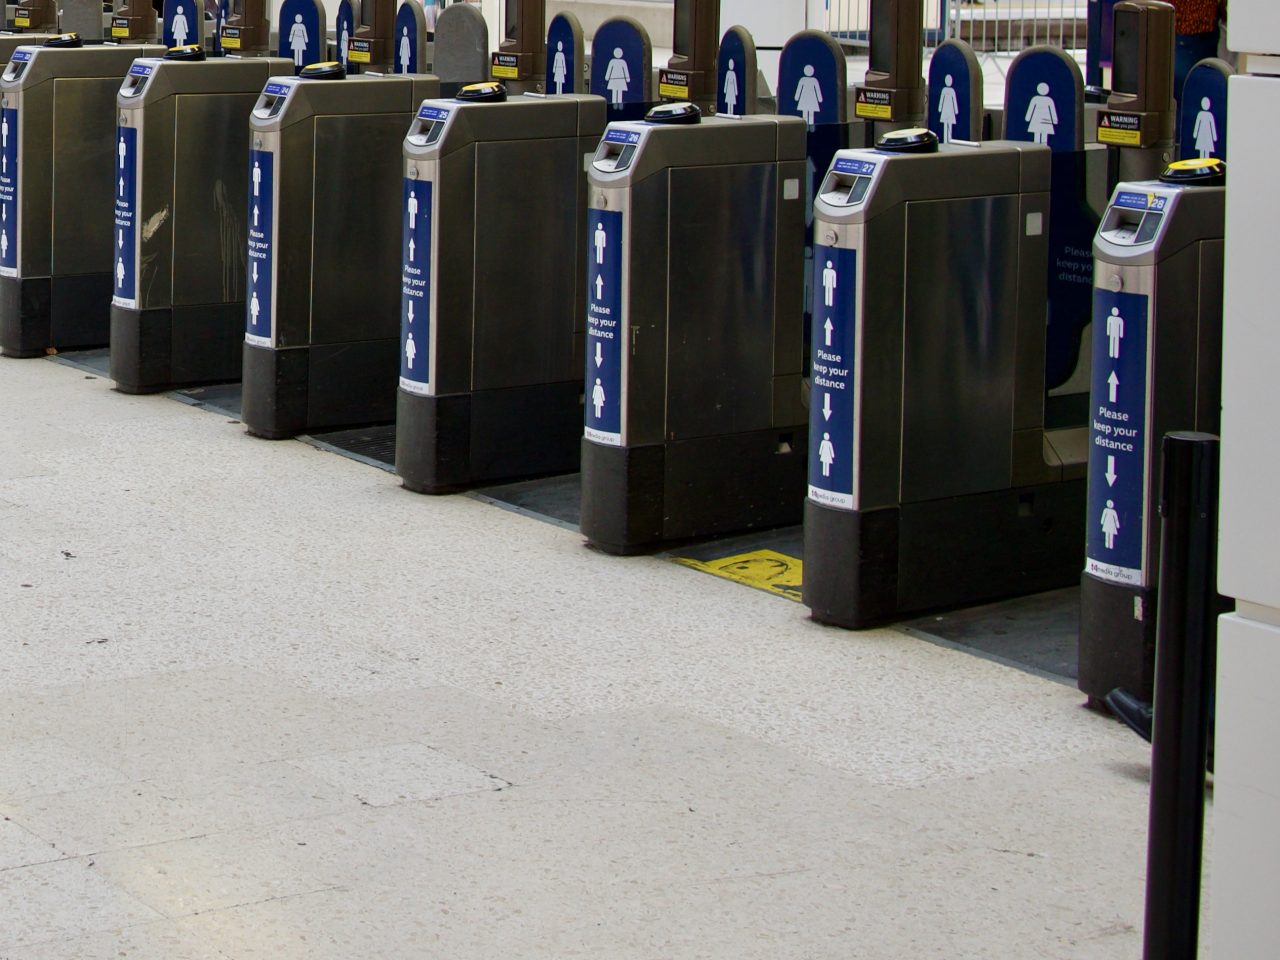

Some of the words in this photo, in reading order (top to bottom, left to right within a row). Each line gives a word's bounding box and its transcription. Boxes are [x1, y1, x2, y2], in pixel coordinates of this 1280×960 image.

[866, 92, 889, 100] WARNING
[439, 110, 448, 119] 25
[1110, 115, 1138, 124] WARNING
[862, 163, 874, 173] 27
[1151, 198, 1165, 209] 28
[1064, 245, 1091, 257] Pleas
[404, 264, 421, 275] Please
[1056, 257, 1079, 272] keep
[1080, 263, 1092, 273] yo
[412, 279, 426, 287] your
[591, 303, 610, 315] Please
[599, 319, 617, 328] your
[589, 327, 614, 339] distance
[817, 349, 842, 362] Please
[813, 361, 828, 375] keep
[829, 367, 849, 376] your
[814, 375, 845, 390] distance
[1099, 406, 1129, 422] Please
[1093, 419, 1112, 435] keep
[1113, 427, 1138, 437] your
[1095, 435, 1133, 452] distance
[1114, 569, 1133, 580] group
